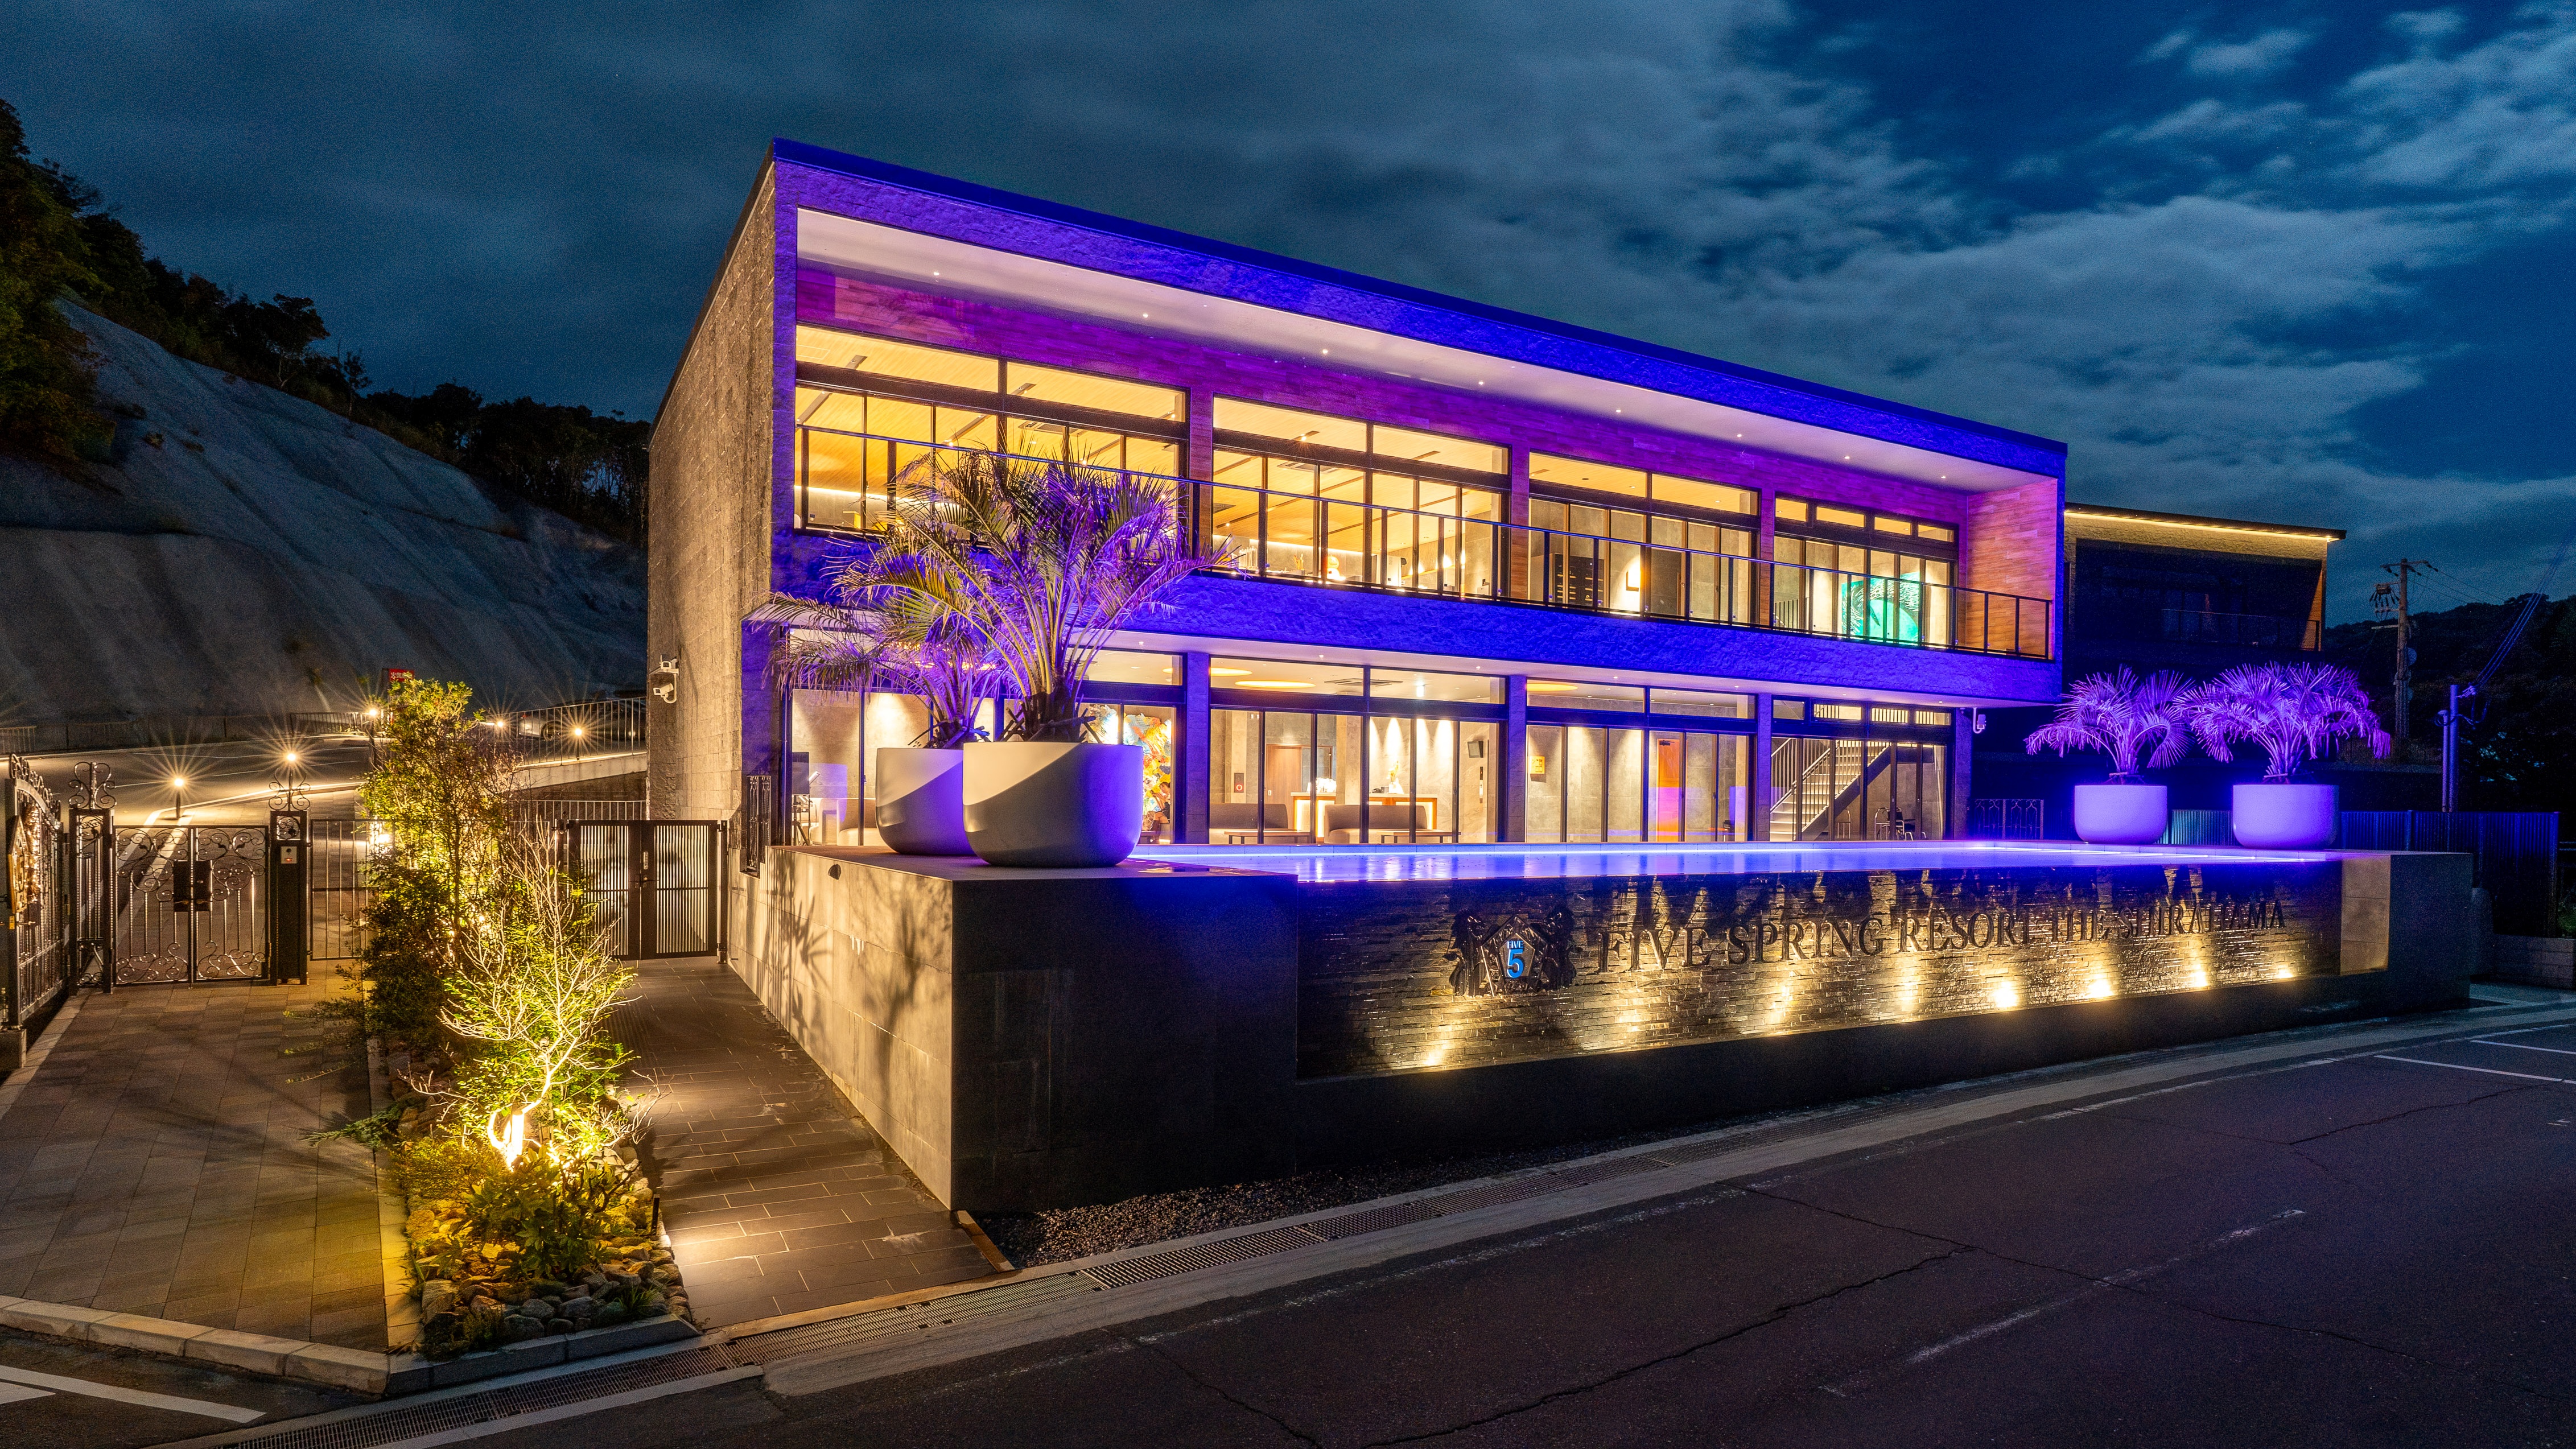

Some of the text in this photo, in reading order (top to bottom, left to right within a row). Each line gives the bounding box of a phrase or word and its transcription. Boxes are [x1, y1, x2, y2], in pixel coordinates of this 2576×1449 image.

[1507, 940, 1524, 949] FIVE
[1593, 927, 1712, 973] FIVE
[1726, 917, 1886, 965] SPRING
[1896, 910, 2039, 952] RESORT
[2045, 907, 2111, 942] THE
[1506, 949, 1524, 979] 5
